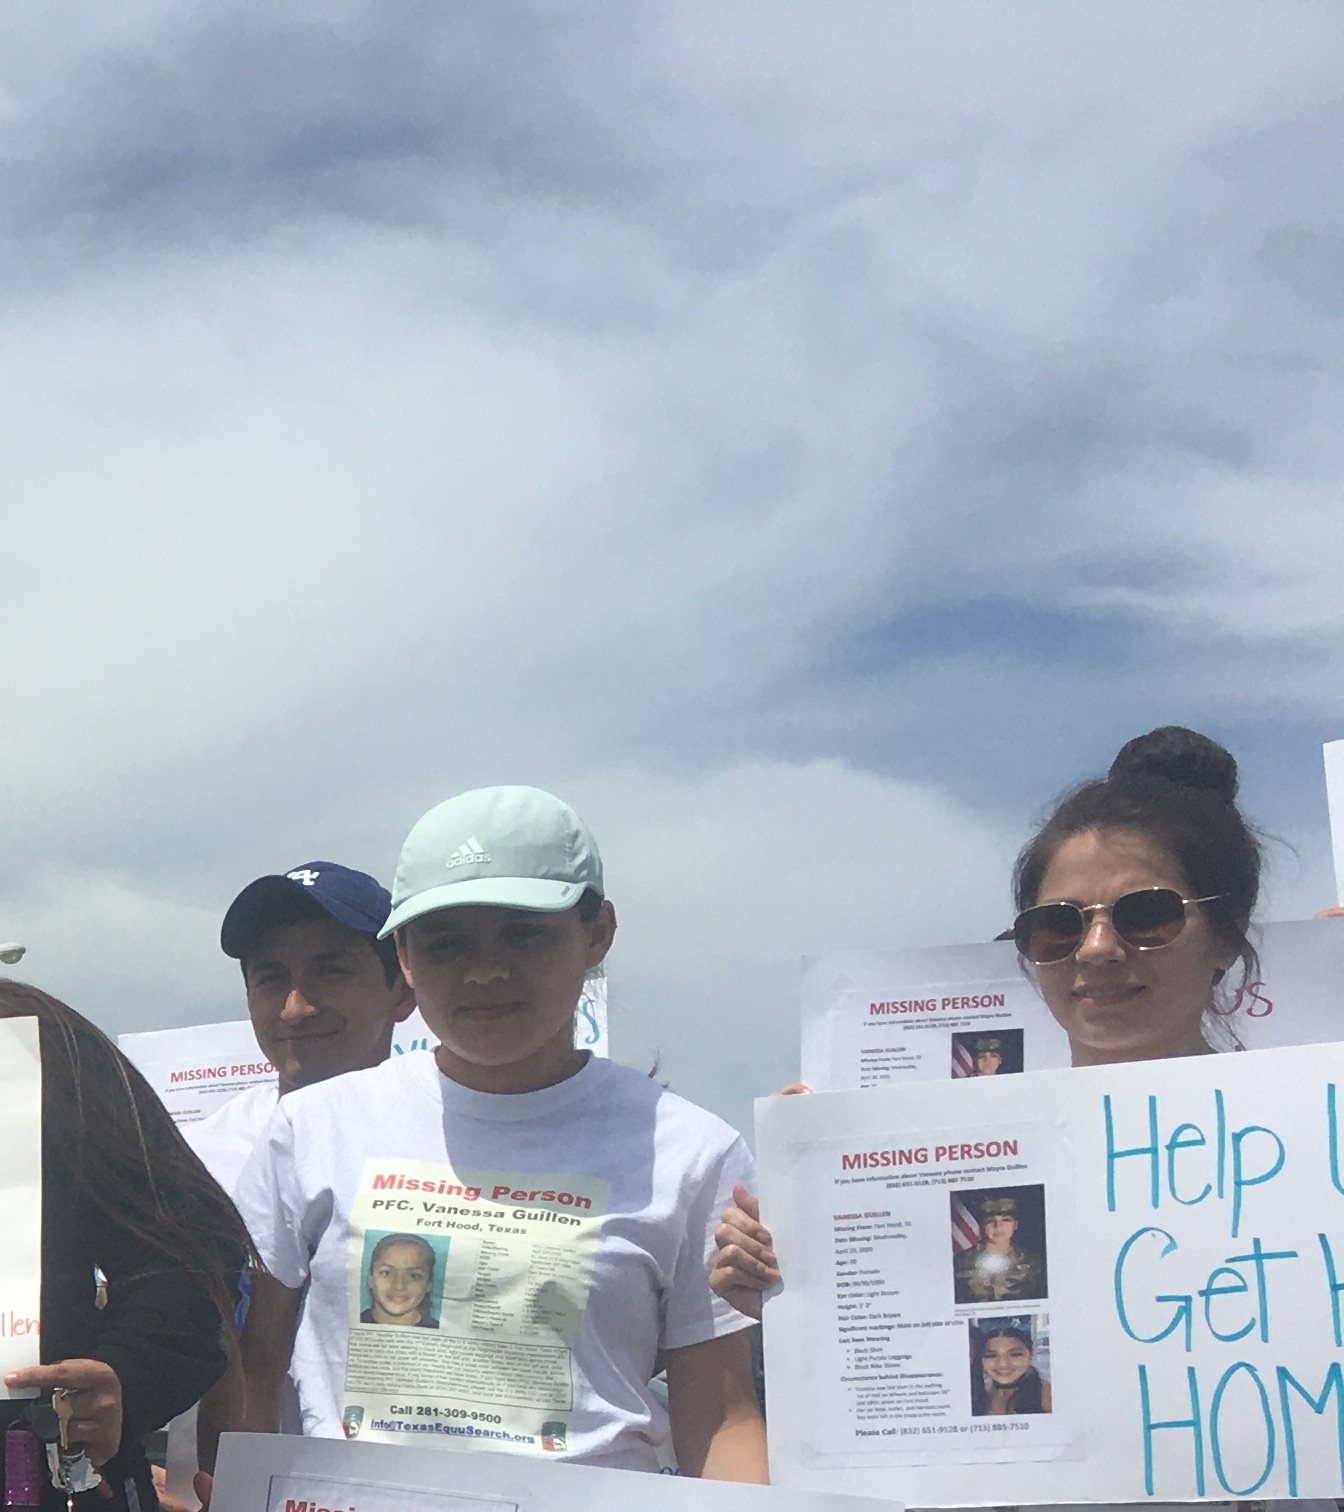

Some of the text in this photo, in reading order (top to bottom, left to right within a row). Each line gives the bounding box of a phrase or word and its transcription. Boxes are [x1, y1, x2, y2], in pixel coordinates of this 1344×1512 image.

[869, 993, 1005, 1016] MISSING PERSON
[841, 1140, 1018, 1171] MISSING PERSON
[1104, 1089, 1286, 1237] Help
[372, 1174, 592, 1209] Missing Person
[372, 1200, 581, 1227] PFC. Vanessa Guillen
[1114, 1227, 1297, 1352] Get
